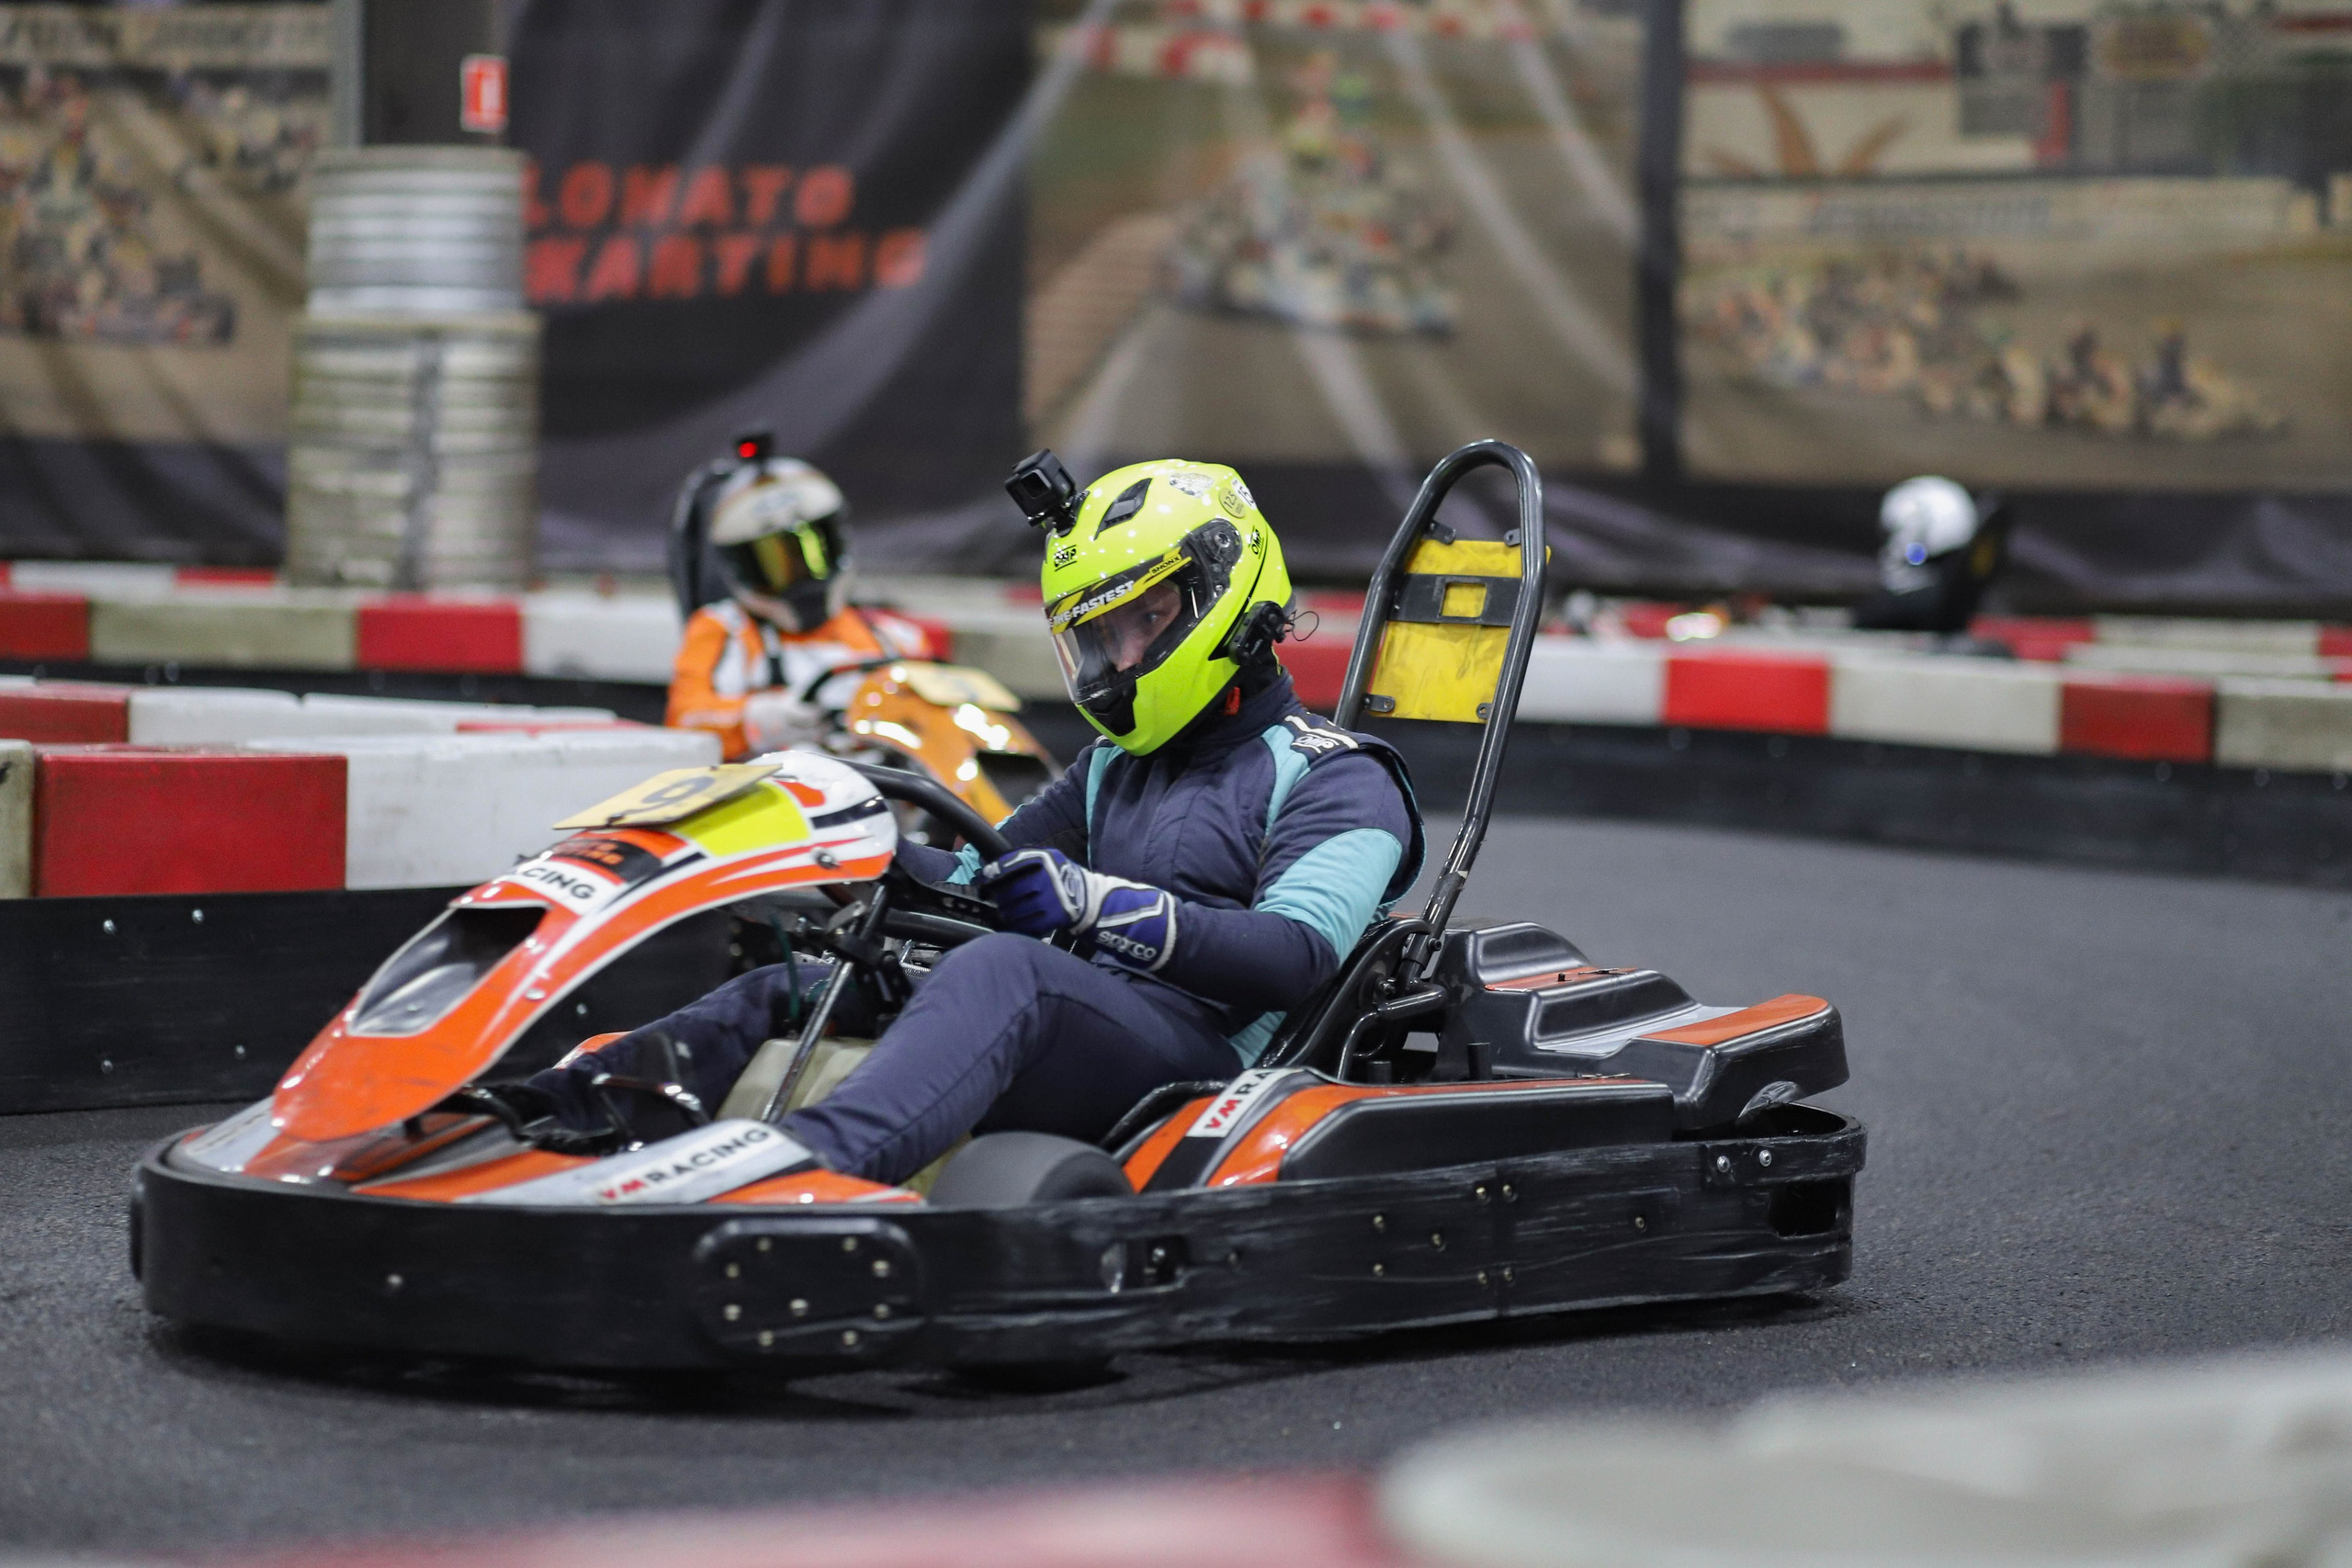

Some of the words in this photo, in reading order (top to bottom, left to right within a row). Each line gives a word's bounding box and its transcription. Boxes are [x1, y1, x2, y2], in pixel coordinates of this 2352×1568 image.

[525, 227, 927, 304] KARTING
[1072, 580, 1135, 618] FASTEST
[522, 867, 596, 898] CING
